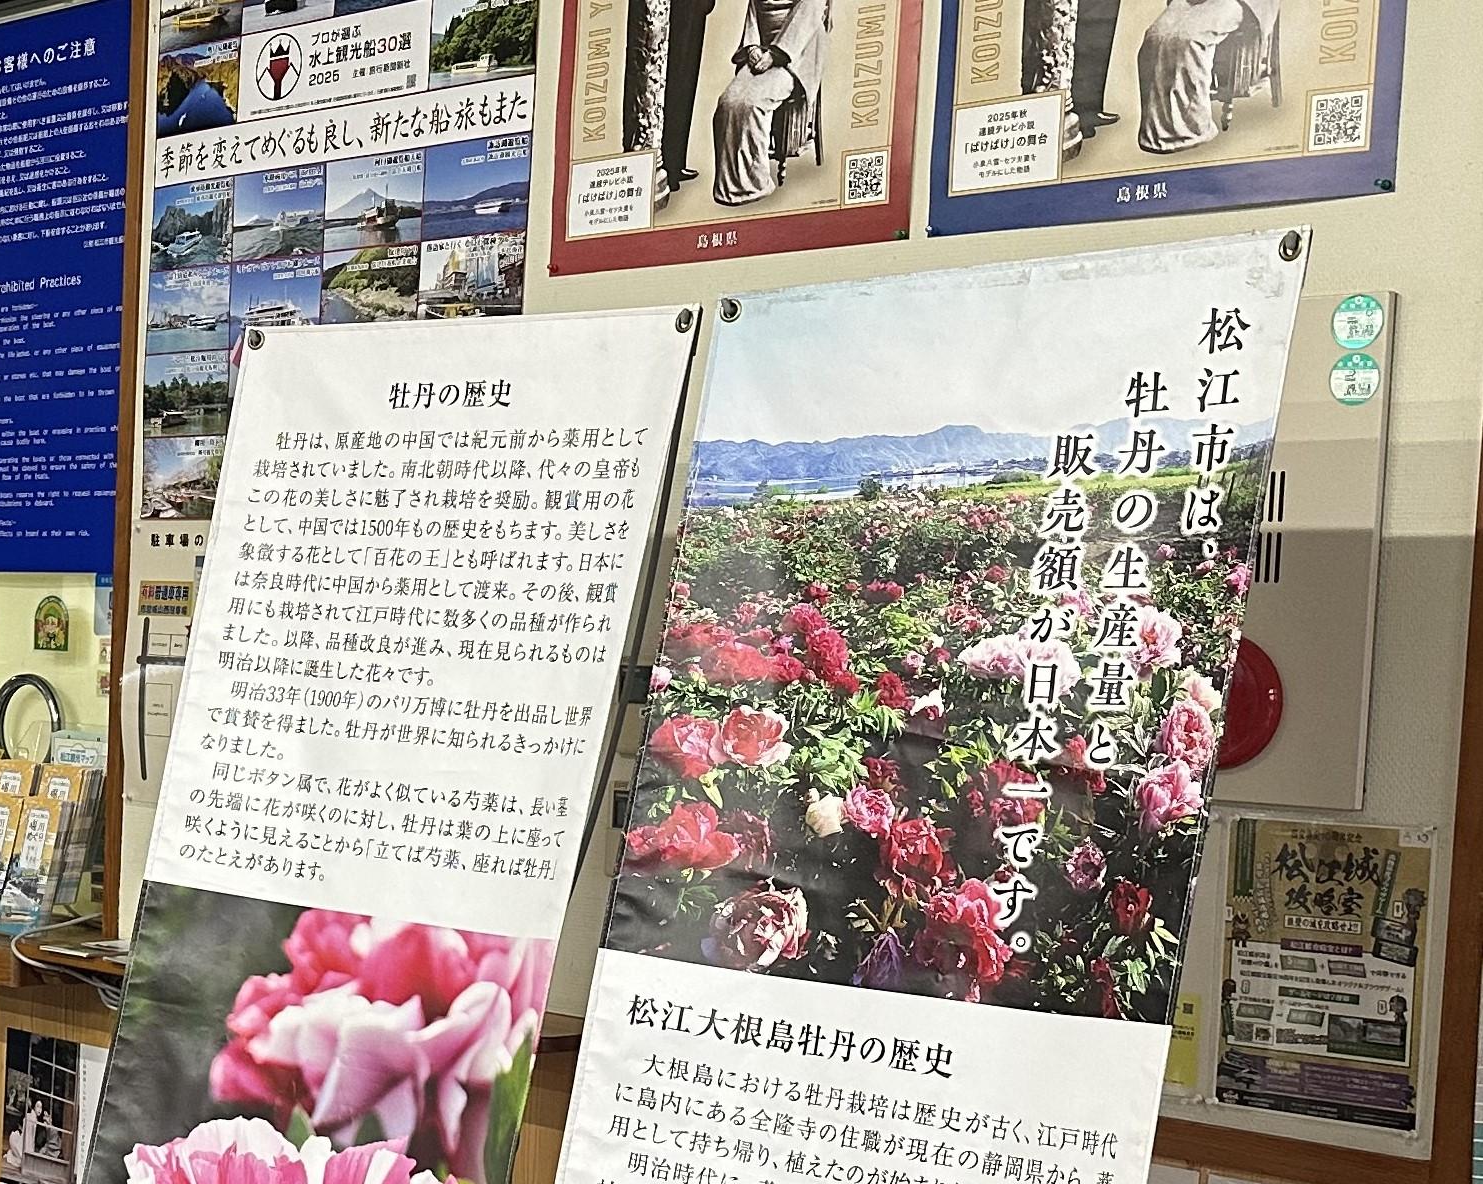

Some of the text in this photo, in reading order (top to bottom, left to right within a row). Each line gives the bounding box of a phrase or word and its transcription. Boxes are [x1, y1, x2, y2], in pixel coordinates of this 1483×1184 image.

[309, 32, 412, 68] 水上観光船30選
[312, 24, 362, 46] プロが選ぶ
[309, 69, 340, 86] 2026
[851, 3, 886, 128] KOIZUMI
[583, 28, 612, 142] KOIZUMI
[160, 90, 527, 178] 季節を変えてめぐるも良し、新たな船旅もまた
[1117, 182, 1168, 204] 島根県
[697, 231, 738, 249] 島根県
[40, 273, 82, 289] Practices
[388, 378, 512, 410] 牡丹の歴史
[276, 427, 649, 453] 牡丹は、原産地の中国では紀元前から薬用として
[1185, 307, 1252, 554] 松江市は、
[252, 457, 641, 480] 栽培されていました。南北朝時代以降、代々の皇帝も
[247, 487, 636, 511] この花の美しさに魅了され栽培を奨励。観賞用の花
[151, 533, 204, 548] 駐車場の
[243, 514, 629, 541] として、中国では1500年もの歴史をもちます。美しさを
[238, 542, 624, 573] 象徴する花として「百花の王」とも呼ばれます。日本に
[1088, 371, 1169, 764] 牡丹の生産量と
[234, 570, 618, 604] は奈良時代に中国から薬用として渡来。その後、観賞
[228, 597, 612, 633] 用にも栽培されて江戸時代に数多くの品種が作られ
[222, 624, 606, 664] ました。以降、品種改良が進み、現在見られるものは
[218, 651, 434, 687] 明治以降に誕生した花々です。
[231, 681, 593, 726] 明治33年(1900年)のパリ万博に牡丹を出品し世界
[992, 433, 1096, 948] 販売額が日本一です。
[201, 732, 284, 761] なりました。
[207, 706, 586, 757] で賞賛を得ました。牡丹が世界に知られるきっかけに
[213, 762, 569, 818] 同じボタン属で、花がよく似ている芍薬は、長い茎
[190, 786, 566, 848] の先端に花が咲くのに対し、牡丹は葉の上に座って
[180, 843, 326, 881] のたとえがあります。
[184, 813, 559, 881] 咲くように見えることから「立てば芍薬、座れば牡丹」
[1271, 842, 1381, 888] 松江城
[626, 994, 954, 1079] 松江大根島牡丹の歴史
[644, 1052, 1118, 1162] 大根島における牡丹栽培は歴史が古く、江戸時代
